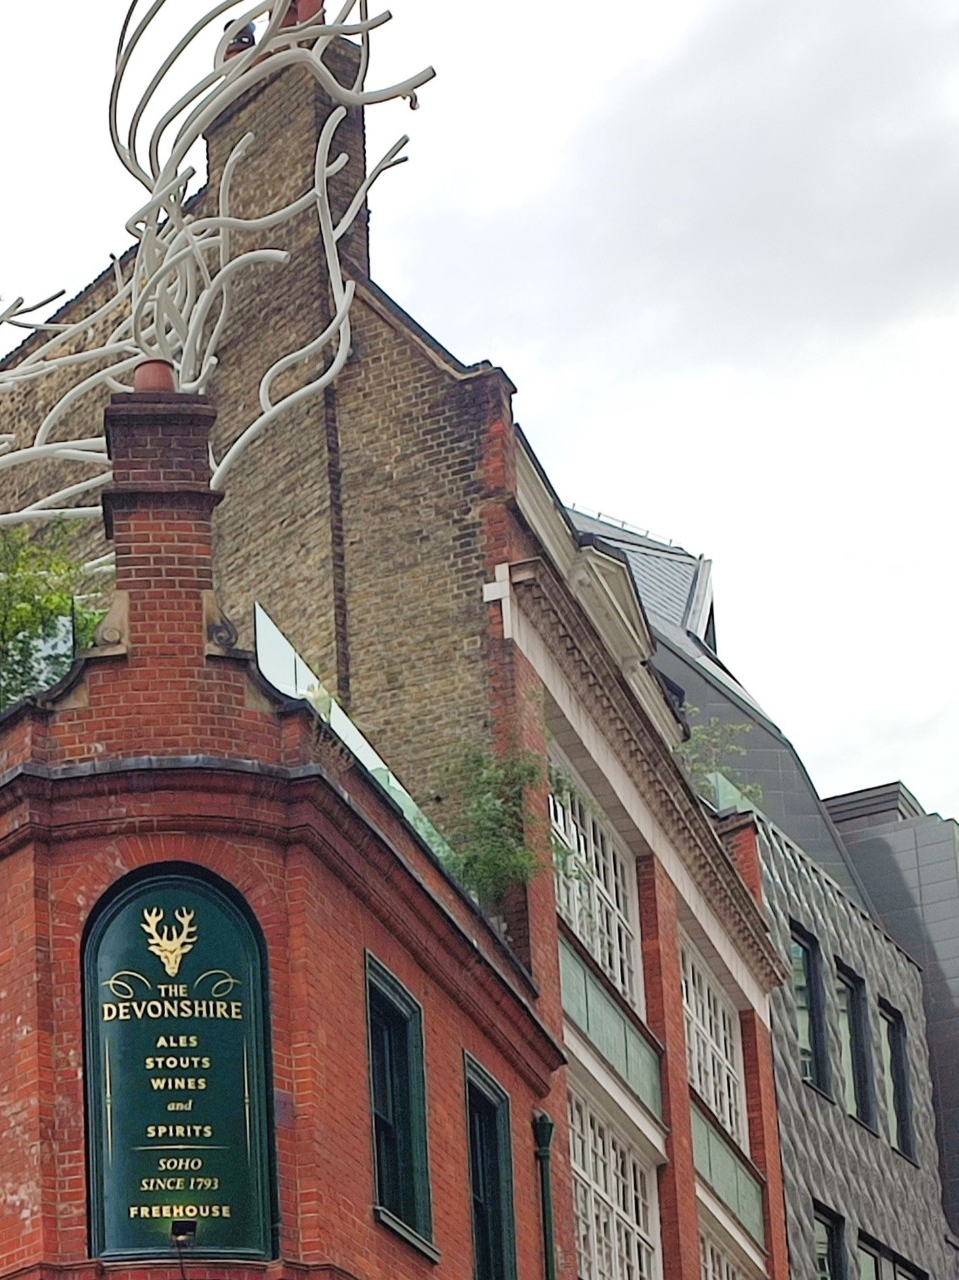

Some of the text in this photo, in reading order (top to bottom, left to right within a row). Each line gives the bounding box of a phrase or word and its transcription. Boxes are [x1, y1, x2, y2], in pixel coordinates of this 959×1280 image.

[157, 984, 188, 998] THE
[102, 1001, 242, 1021] DEVONSHIRE
[156, 1035, 198, 1048] ALES
[145, 1057, 211, 1069] STOUTS
[150, 1078, 207, 1090] WINES
[167, 1100, 193, 1112] and
[146, 1125, 213, 1138] SPIRITS
[158, 1158, 202, 1171] SOHO
[140, 1177, 219, 1191] SINCE 1793
[129, 1205, 231, 1218] FREEHOUSE
